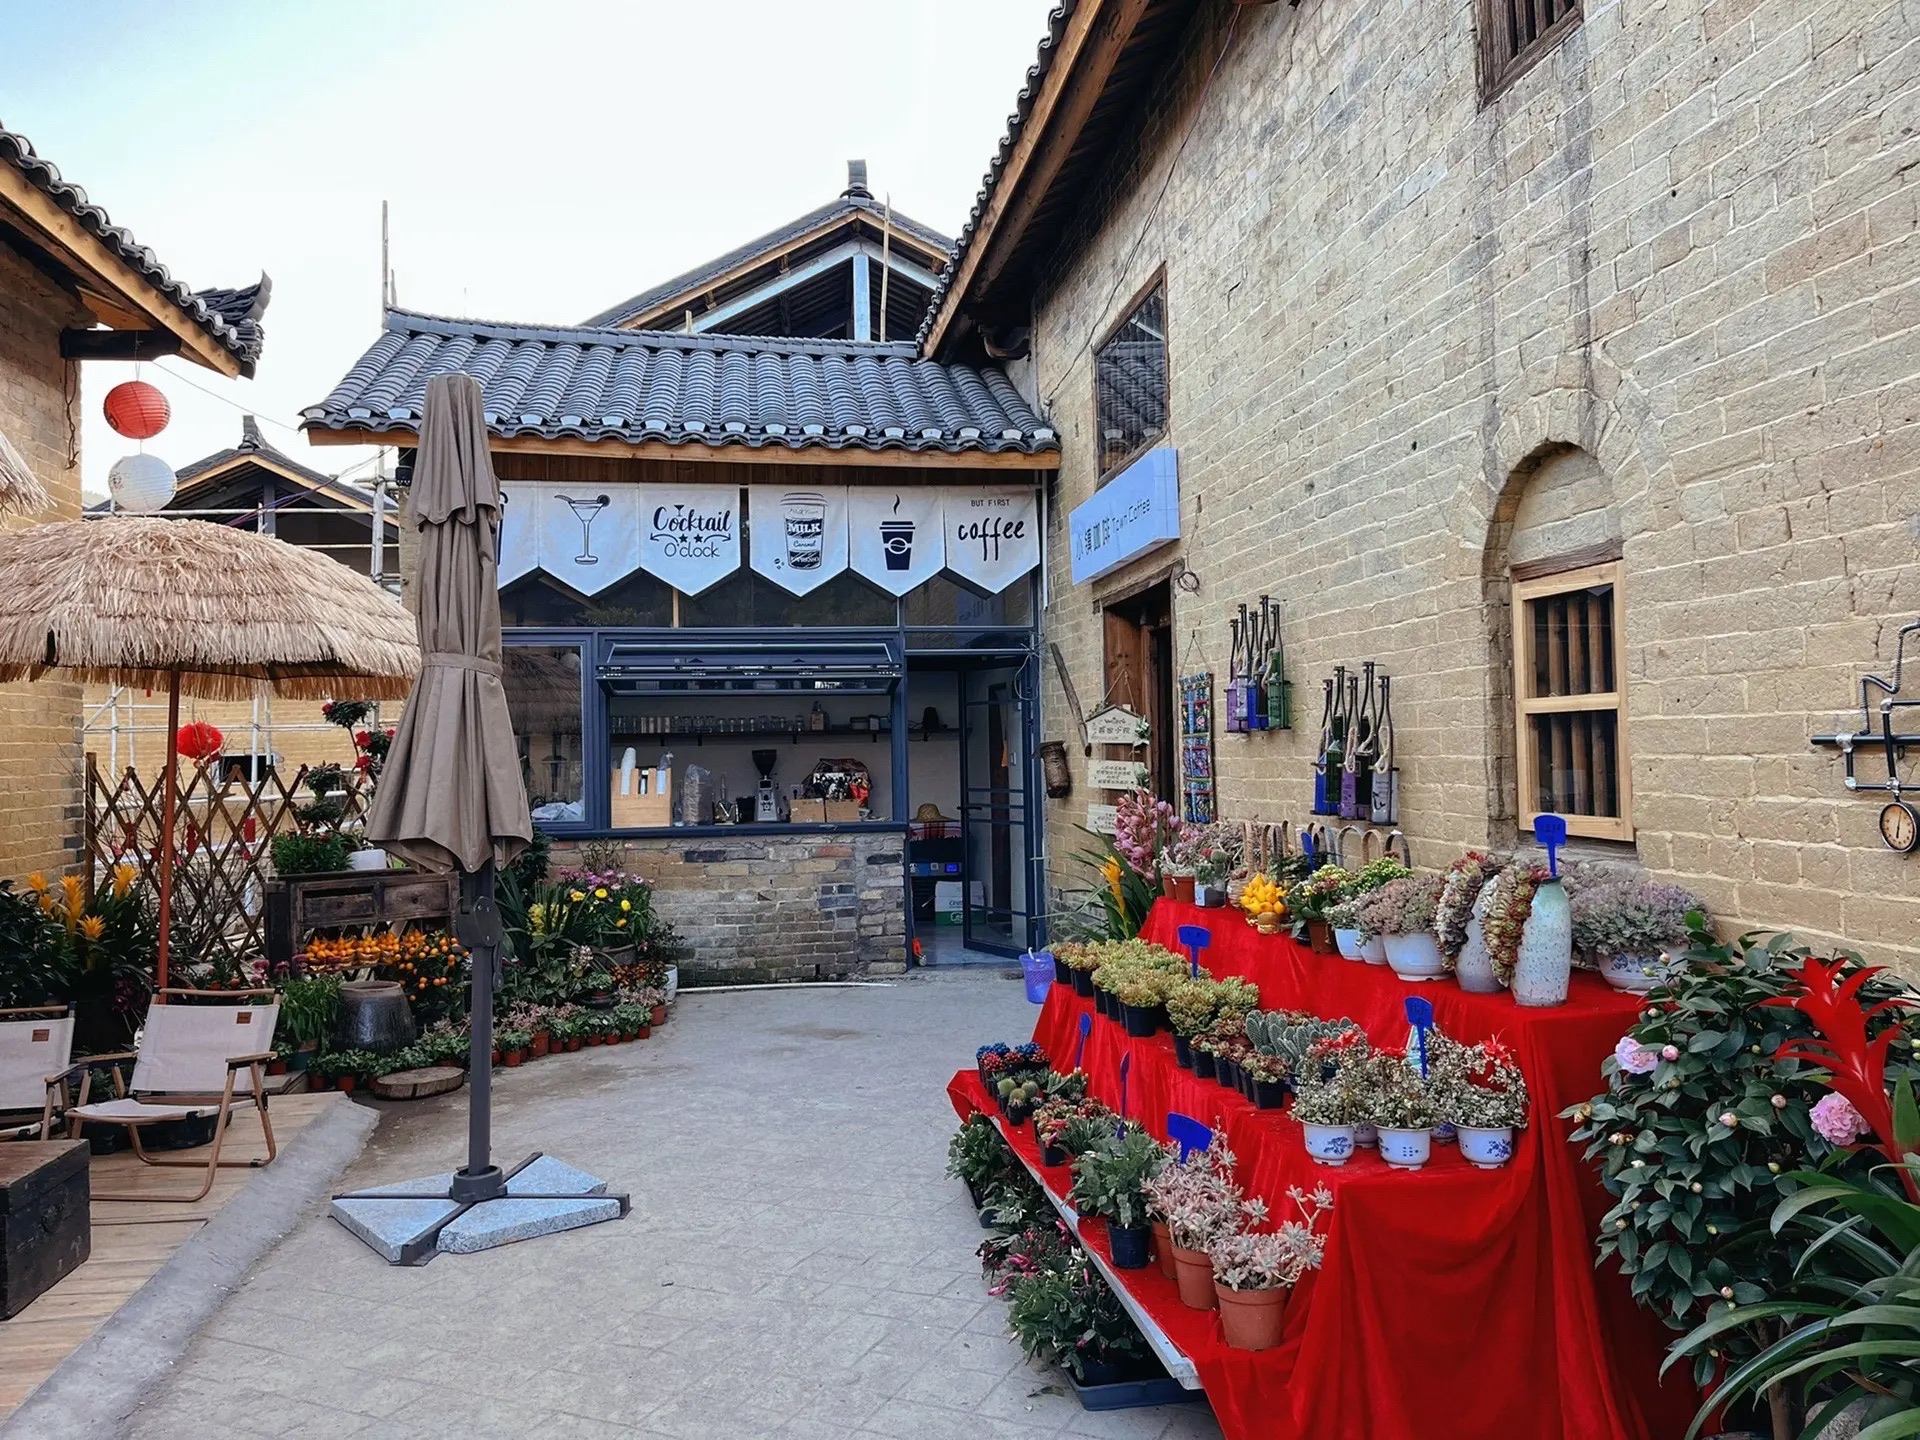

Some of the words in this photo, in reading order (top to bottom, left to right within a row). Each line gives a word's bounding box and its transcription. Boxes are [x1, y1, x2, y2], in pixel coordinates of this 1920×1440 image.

[970, 499, 984, 507] BUT
[988, 499, 1010, 507] FIRST
[653, 506, 732, 532] Cocktail
[787, 522, 822, 533] MILK
[958, 516, 1025, 562] coffee
[664, 541, 720, 558] O'clock
